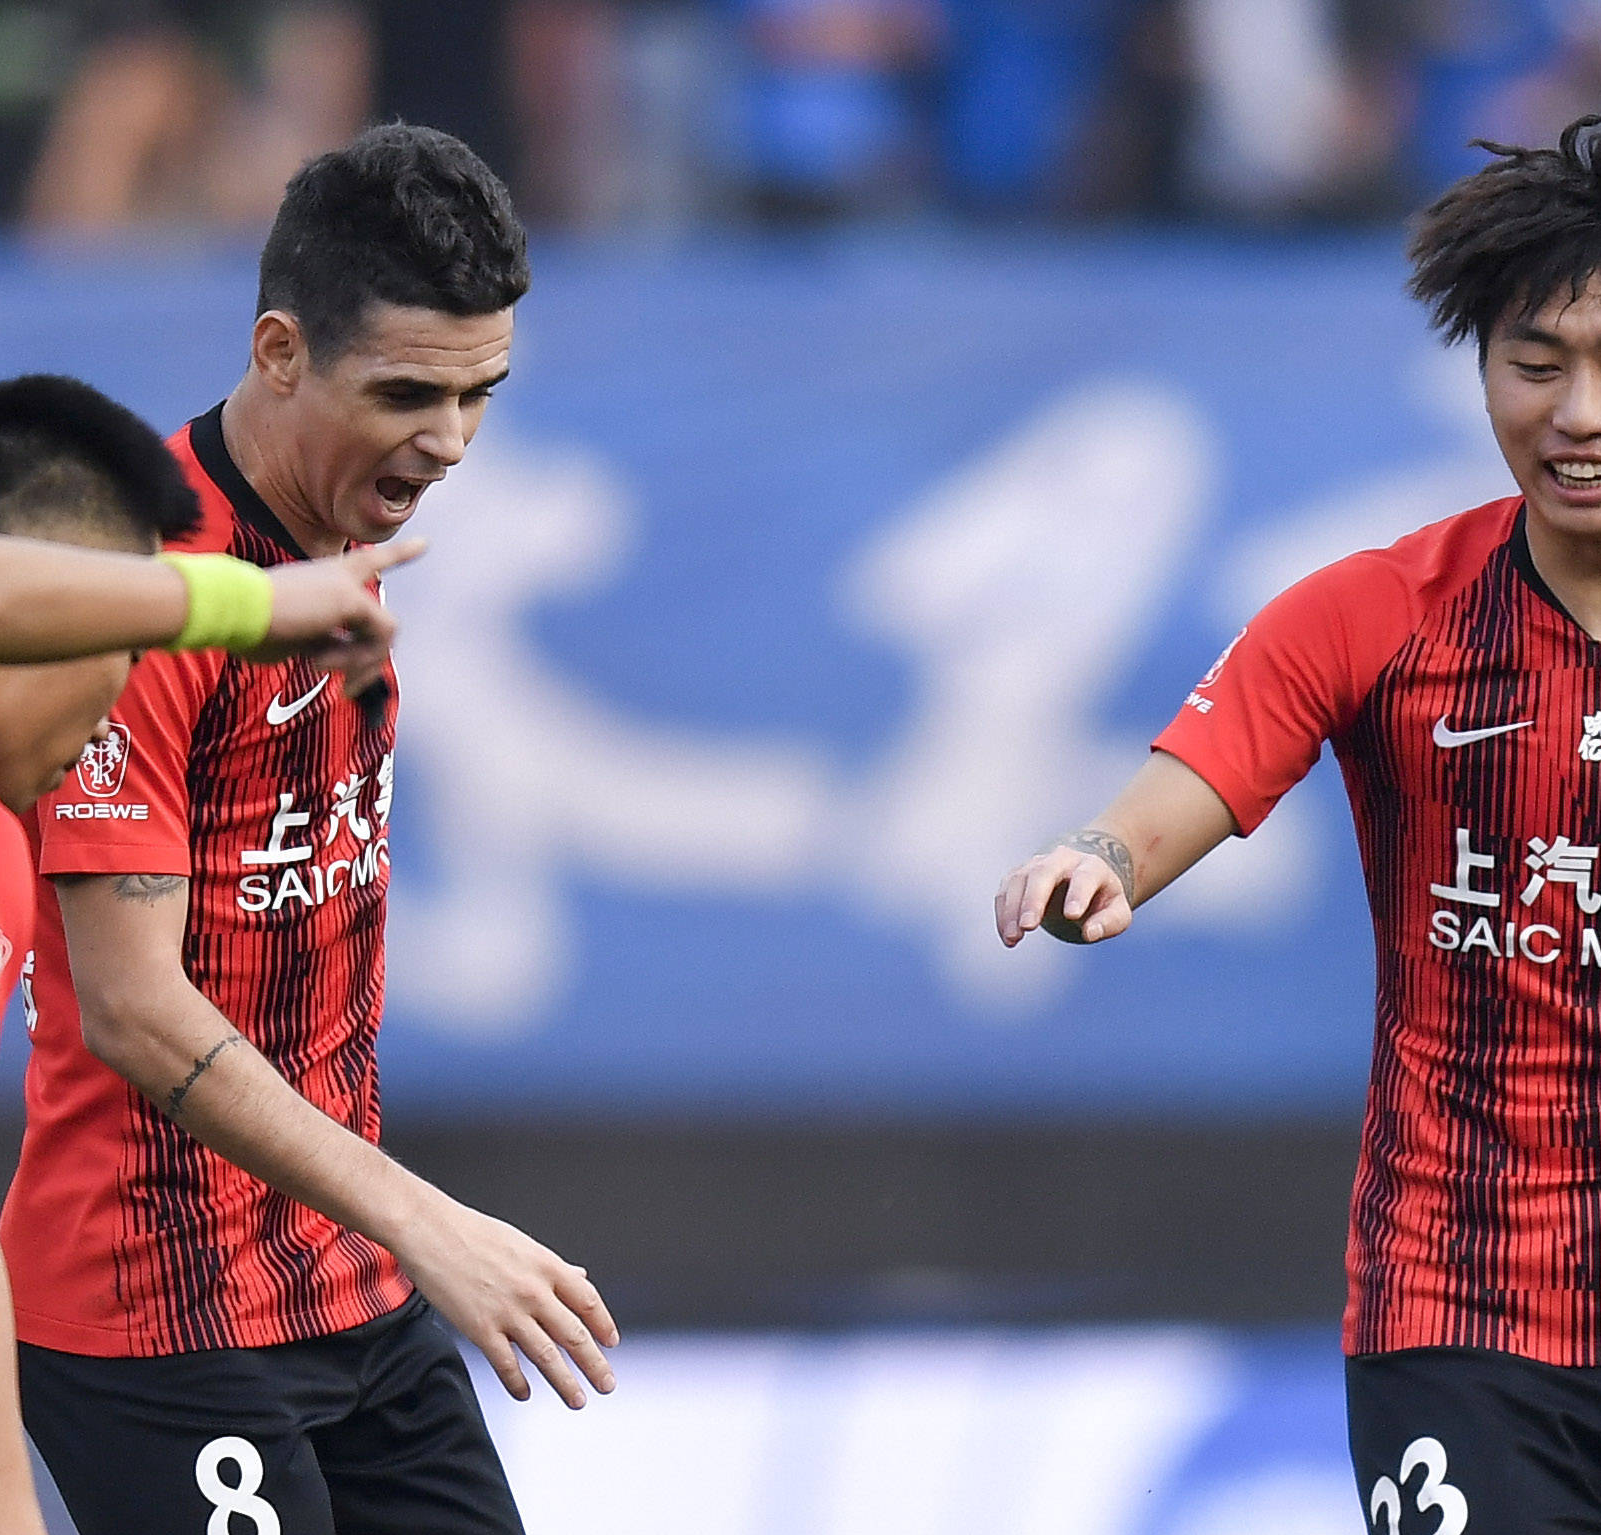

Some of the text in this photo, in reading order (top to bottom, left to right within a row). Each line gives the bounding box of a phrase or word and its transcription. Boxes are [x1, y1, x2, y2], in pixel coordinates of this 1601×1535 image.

[55, 803, 150, 820] ROEWE
[236, 858, 351, 912] SAIC
[1429, 910, 1561, 965] SAIC
